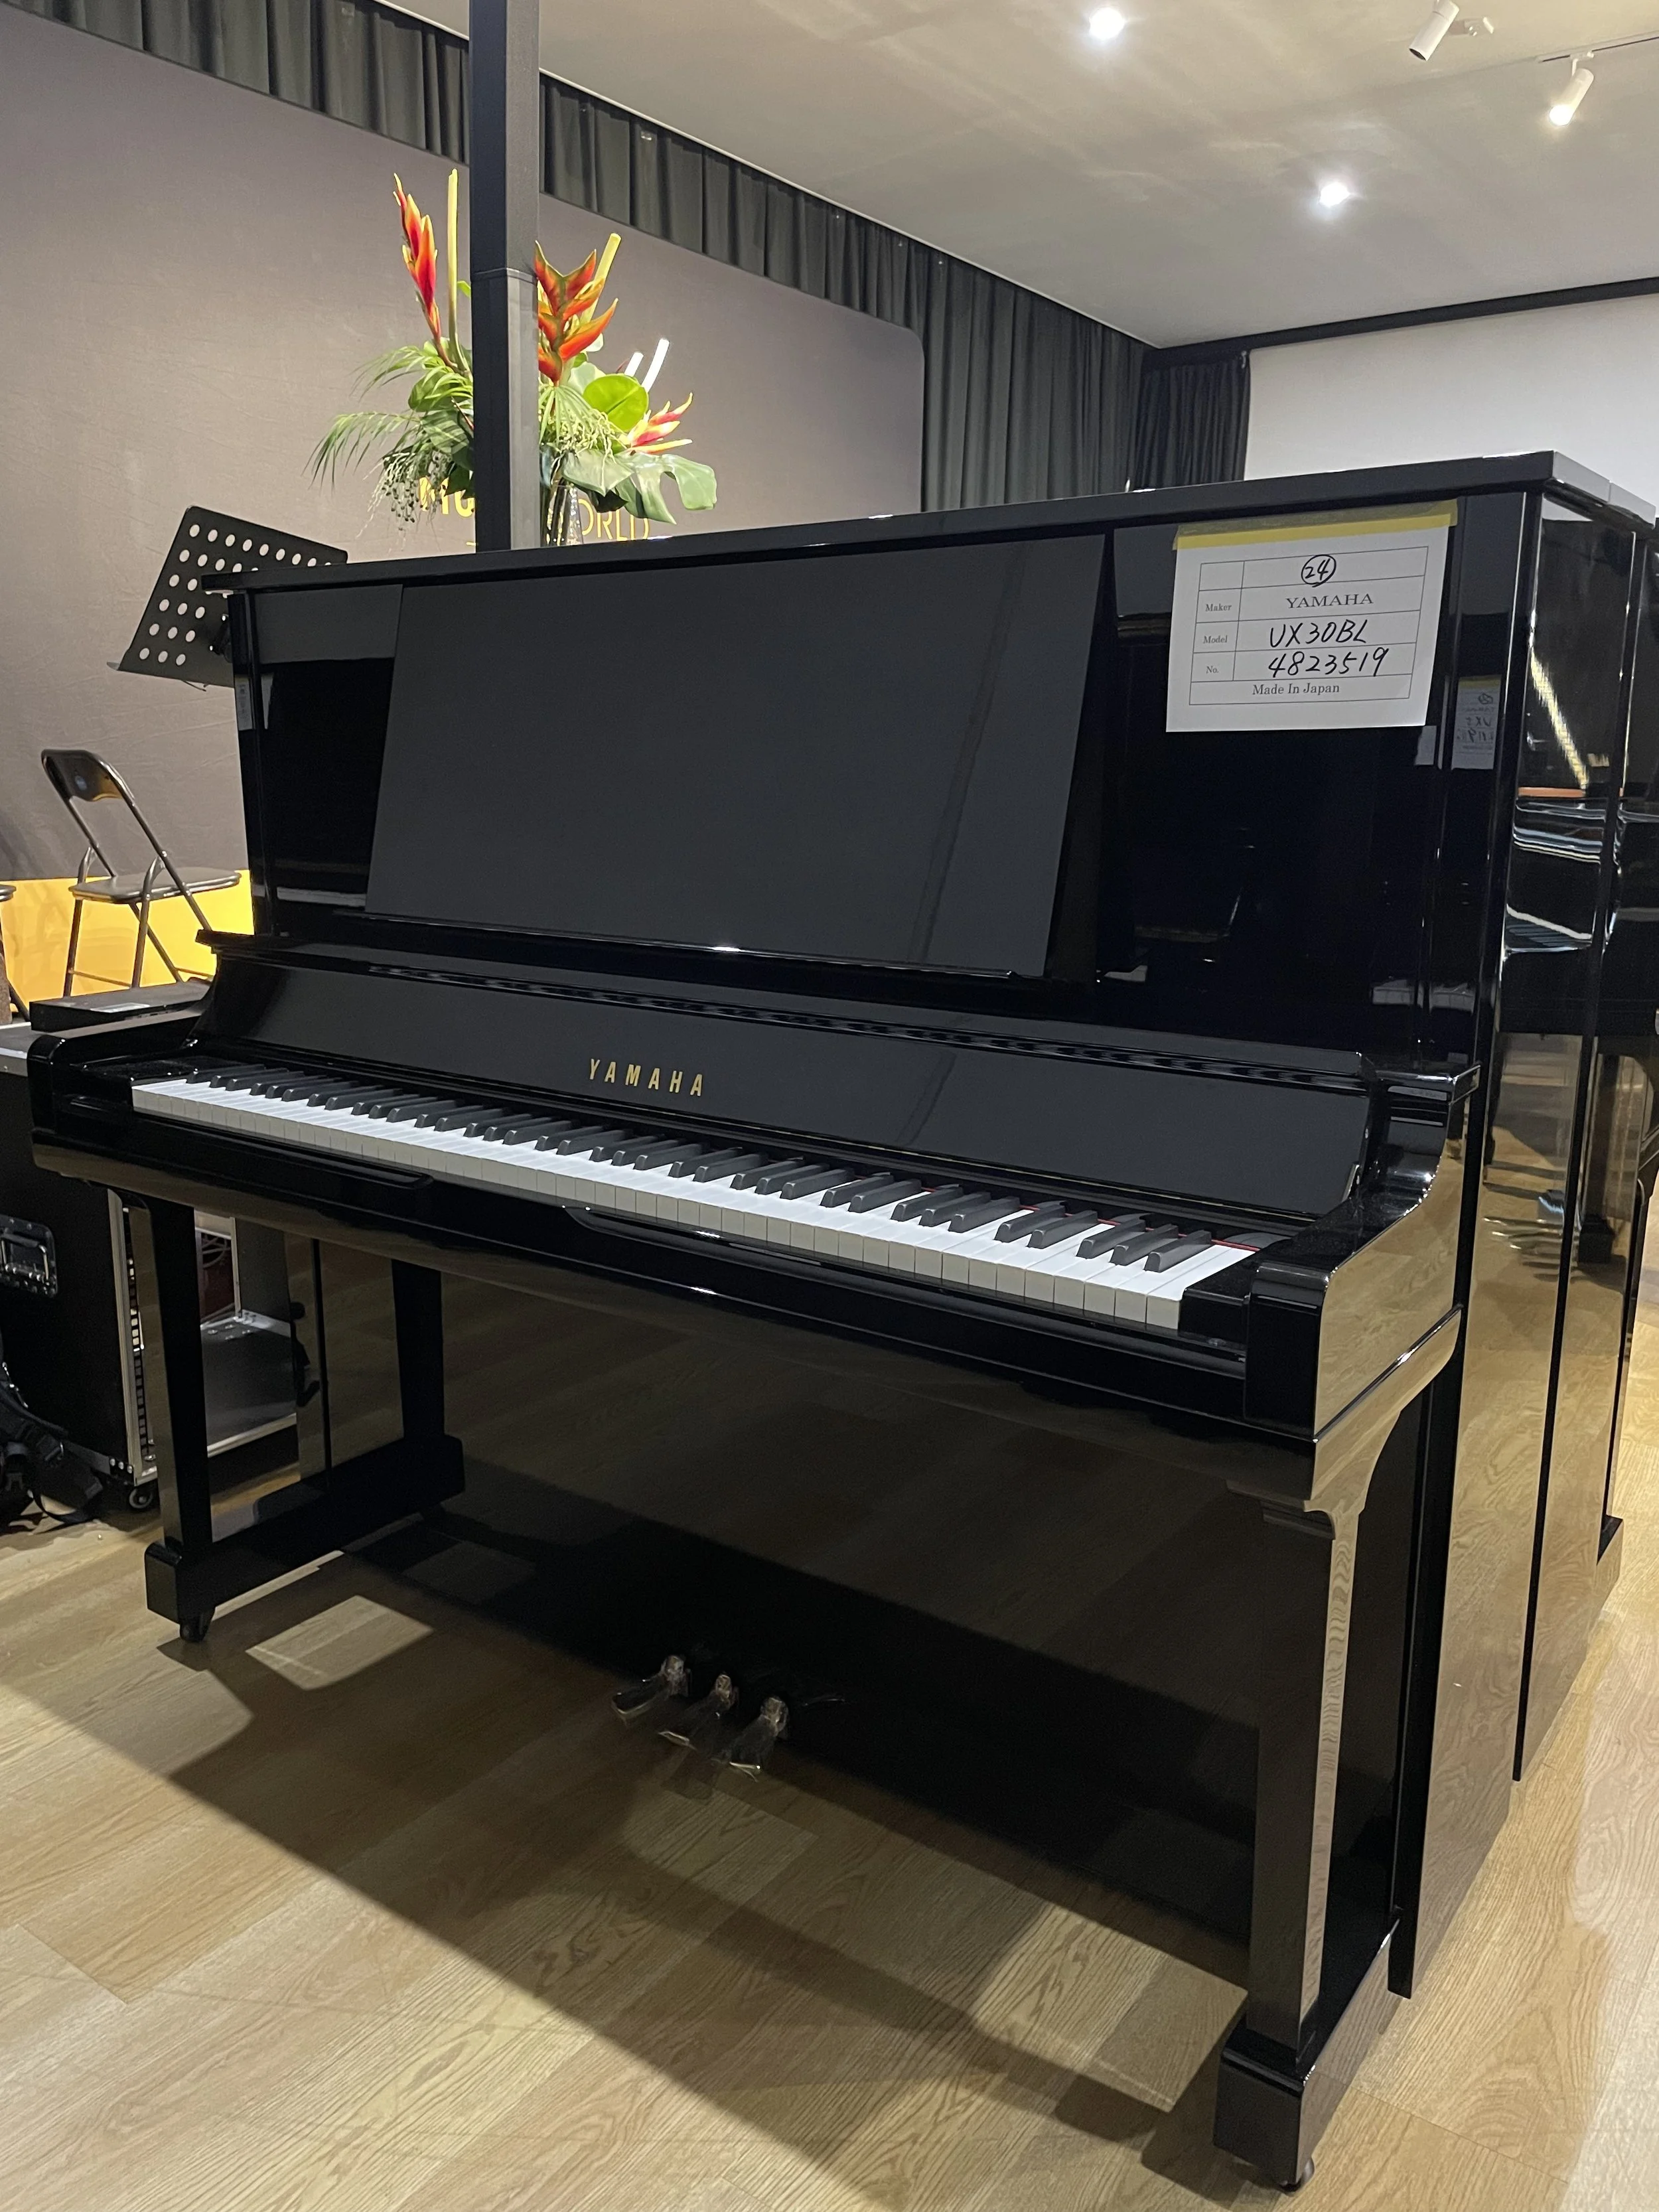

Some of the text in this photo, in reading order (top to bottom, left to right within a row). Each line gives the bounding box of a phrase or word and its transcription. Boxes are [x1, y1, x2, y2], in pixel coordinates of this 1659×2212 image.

[577, 498, 649, 541] ORLD
[1304, 557, 1332, 582] 24
[1205, 603, 1232, 612] Maker
[1286, 593, 1374, 609] YAMAHA
[1202, 635, 1228, 644] Model
[1269, 619, 1368, 648] UX30BL
[1268, 647, 1390, 678] 4823519
[1252, 682, 1340, 696] Made In Japan
[589, 1058, 703, 1096] YAMAHA
